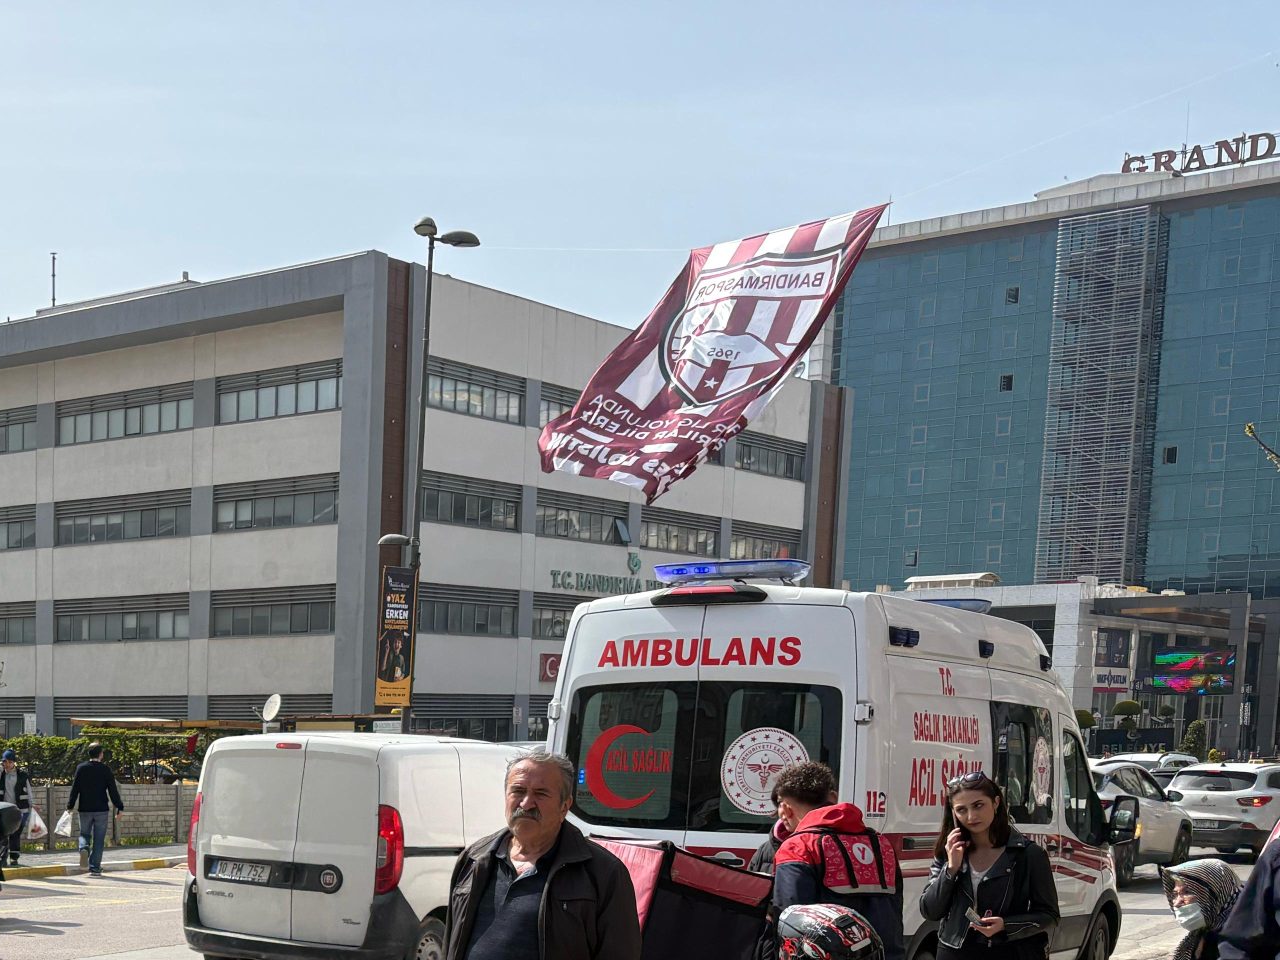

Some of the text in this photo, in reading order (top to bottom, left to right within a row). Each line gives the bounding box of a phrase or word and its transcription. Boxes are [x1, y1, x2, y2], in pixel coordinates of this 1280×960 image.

[1121, 132, 1277, 173] GRAND
[575, 572, 643, 593] BANDIRMA
[385, 608, 409, 619] ERKEN
[597, 636, 803, 668] AMBULANS
[938, 667, 956, 697] T.C.
[913, 709, 980, 745] SAĞLIK BAKANLIĞI
[605, 742, 673, 773] ACİL SAĞLIK
[908, 756, 937, 807] ACİL
[866, 790, 887, 813] 112
[218, 862, 265, 878] 10 PM 752
